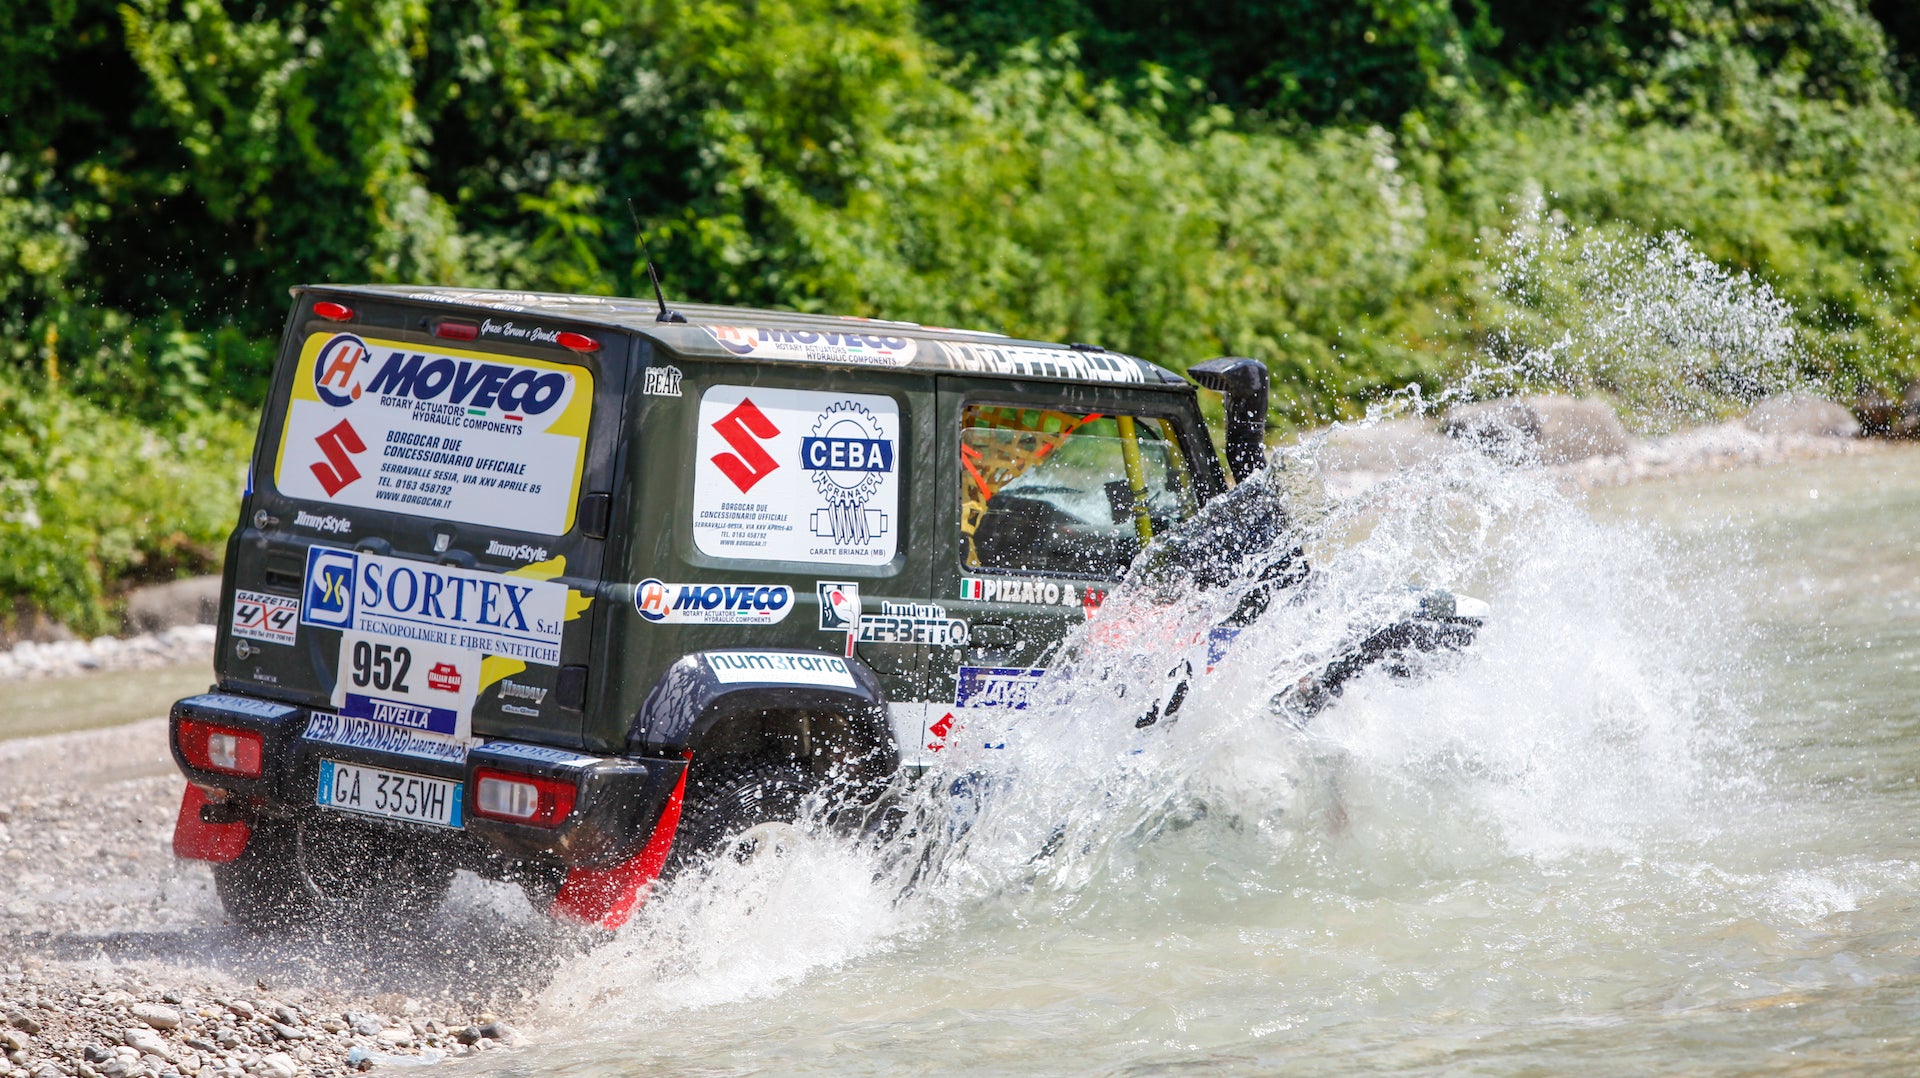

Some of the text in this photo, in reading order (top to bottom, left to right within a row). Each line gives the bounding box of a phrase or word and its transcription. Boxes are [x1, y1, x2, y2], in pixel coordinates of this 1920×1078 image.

[757, 328, 907, 350] MOVECO
[775, 343, 847, 354] ROTARY ACTUATORS
[806, 352, 897, 365] HYDRAULIC COMPONENTS
[366, 352, 566, 415] MOVECO
[645, 367, 681, 394] PEAK
[380, 396, 465, 417] ROTARY ACTUATORS
[412, 411, 523, 435] HYDRAULIC COMPONENTS
[386, 431, 462, 451] BORGOCAR DUE
[383, 445, 527, 475] CONCESSIONARIO UFFICIALE
[809, 441, 884, 469] CEBA
[378, 476, 452, 495] TEL. 0163 458792
[381, 463, 542, 494] SERRAVALLE SESIA, VIA XXV APRILE 85
[819, 471, 876, 499] INGRANAGGI
[375, 490, 452, 509] WWW.BORGOCAR.IT
[721, 503, 768, 512] BORGOCAR DUE
[694, 521, 726, 529] SERRAVALLE
[700, 511, 788, 521] CONCESSIONARIO UFFICIALE
[870, 549, 886, 557] (MB)
[237, 592, 298, 608] GAZZETTA
[361, 562, 533, 633] SORTEX
[672, 586, 788, 611] MOVECO
[984, 578, 1059, 604] PIZZATO
[360, 618, 448, 644] TECNOPOLIMERI
[450, 634, 457, 646] E
[460, 635, 493, 651] FIBRE
[537, 619, 561, 635] S.r.l.
[353, 641, 412, 694] 952
[369, 699, 432, 729] TAVELLA
[306, 713, 339, 740] CEBA
[338, 717, 411, 751] INGRANAGGI
[335, 768, 446, 820] GA 335VH
